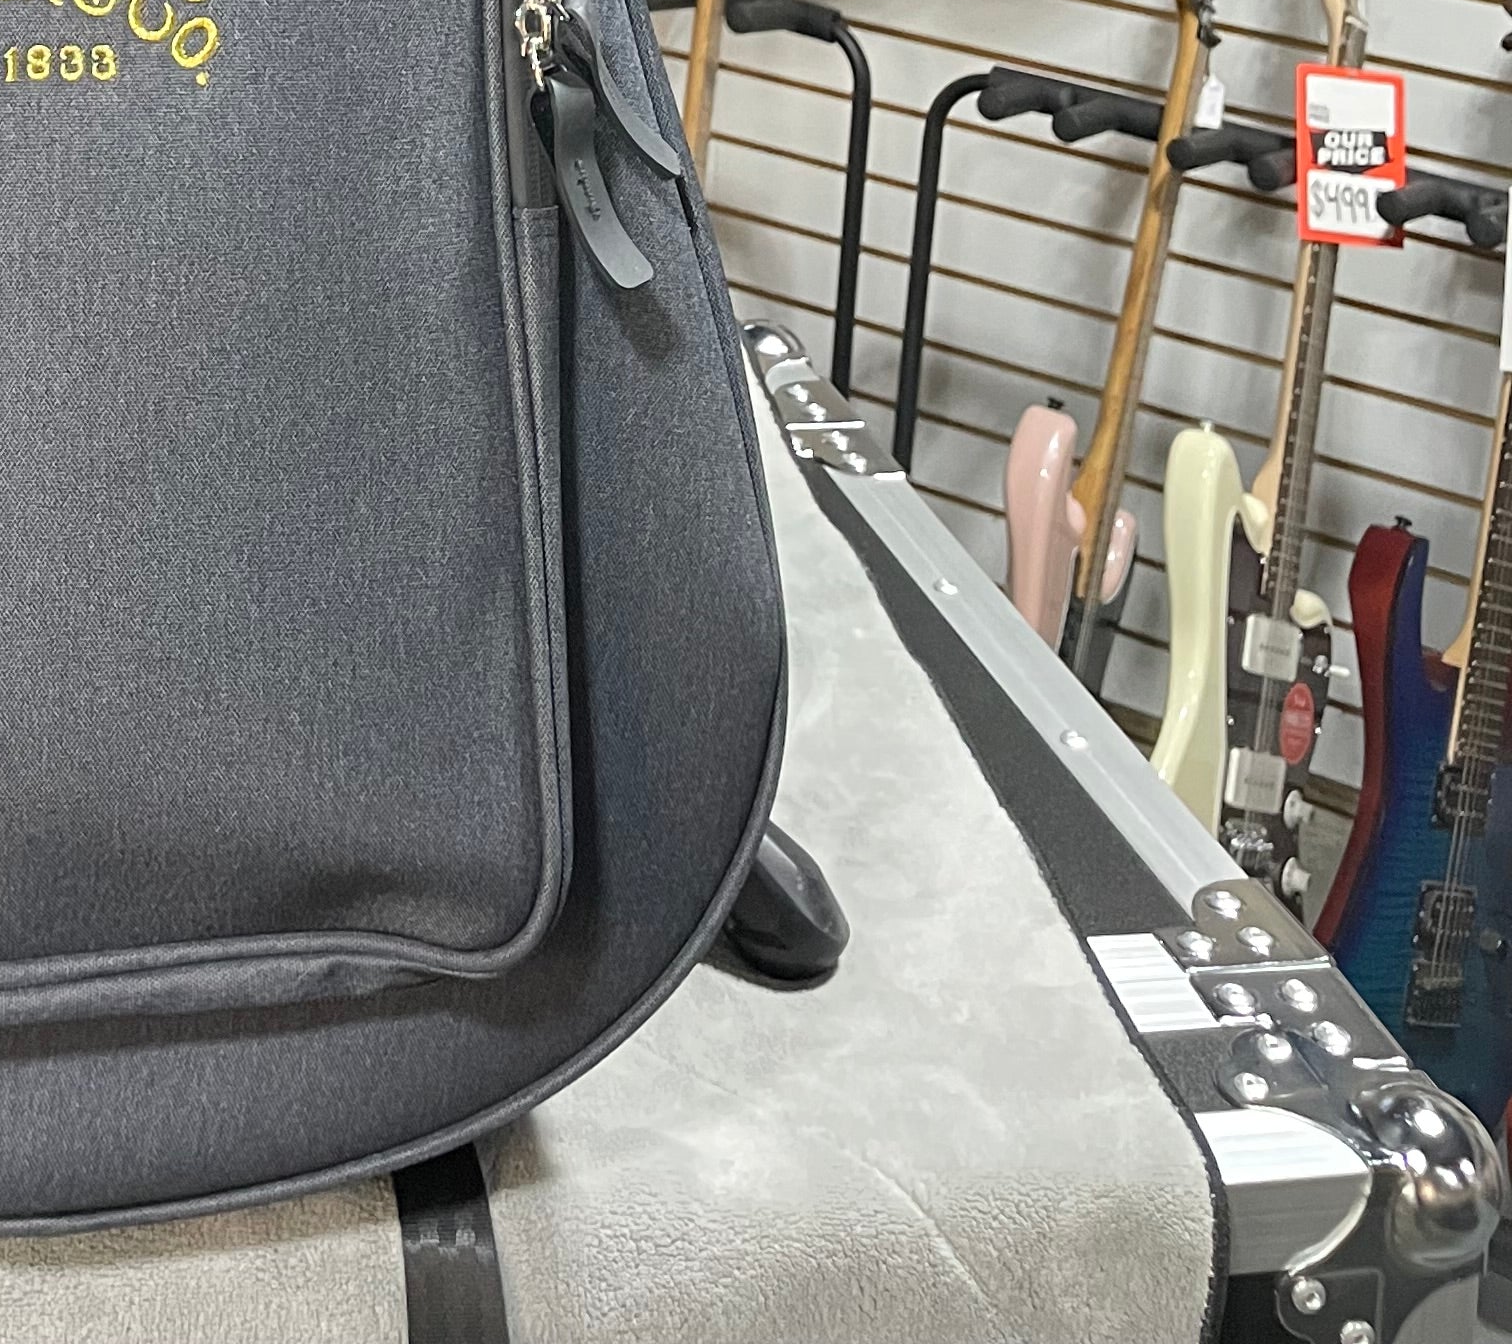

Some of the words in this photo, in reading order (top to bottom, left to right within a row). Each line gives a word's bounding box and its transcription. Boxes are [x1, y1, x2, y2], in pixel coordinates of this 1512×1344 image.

[3, 43, 118, 83] 1833
[1324, 131, 1374, 148] OUR
[1317, 146, 1386, 166] PRICE
